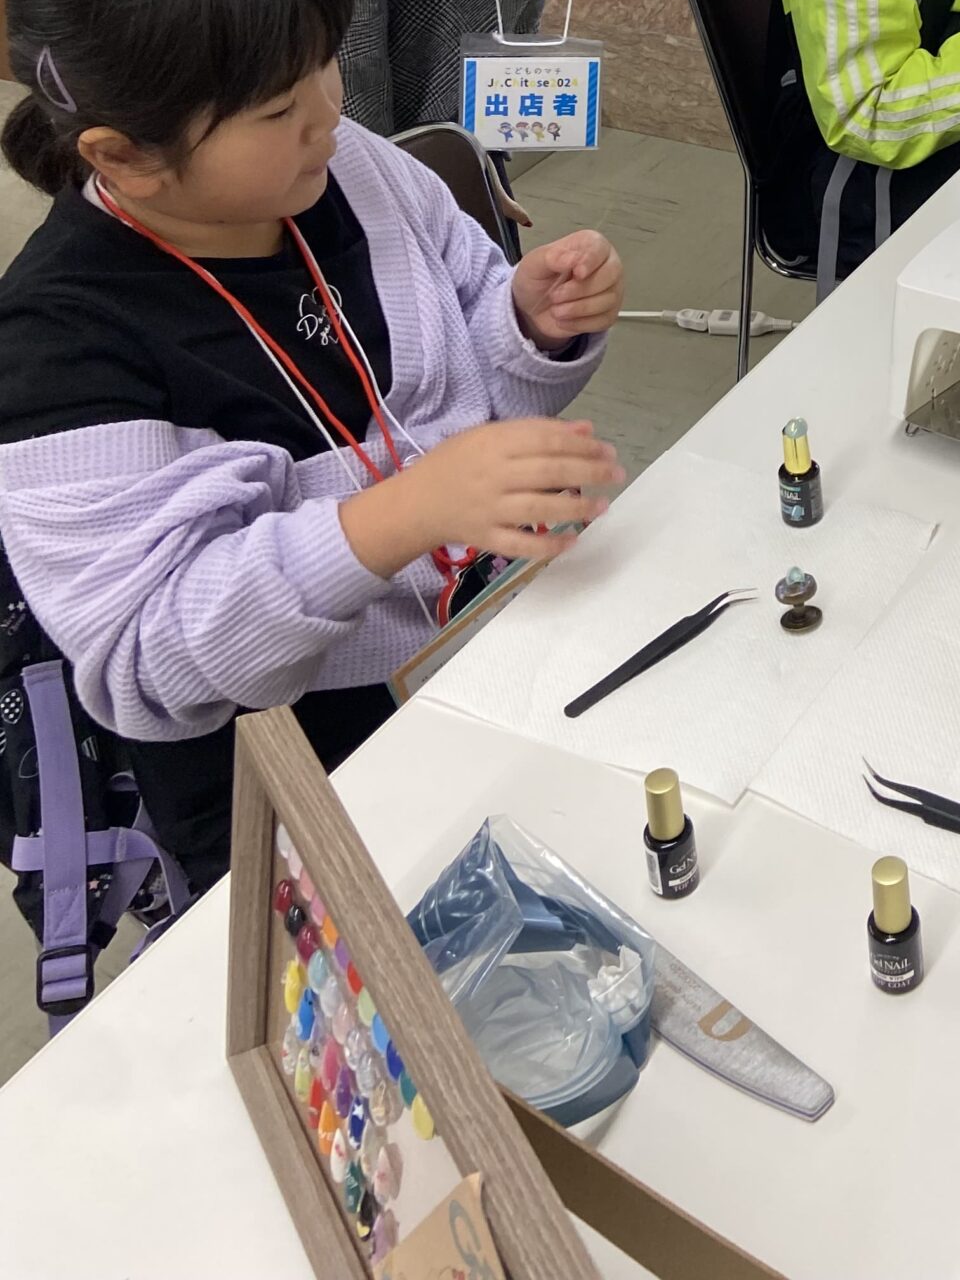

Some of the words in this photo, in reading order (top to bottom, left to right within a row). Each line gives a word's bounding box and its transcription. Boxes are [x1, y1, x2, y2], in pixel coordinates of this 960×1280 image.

[504, 67, 561, 75] こどものマチ
[485, 93, 578, 117] 出店者
